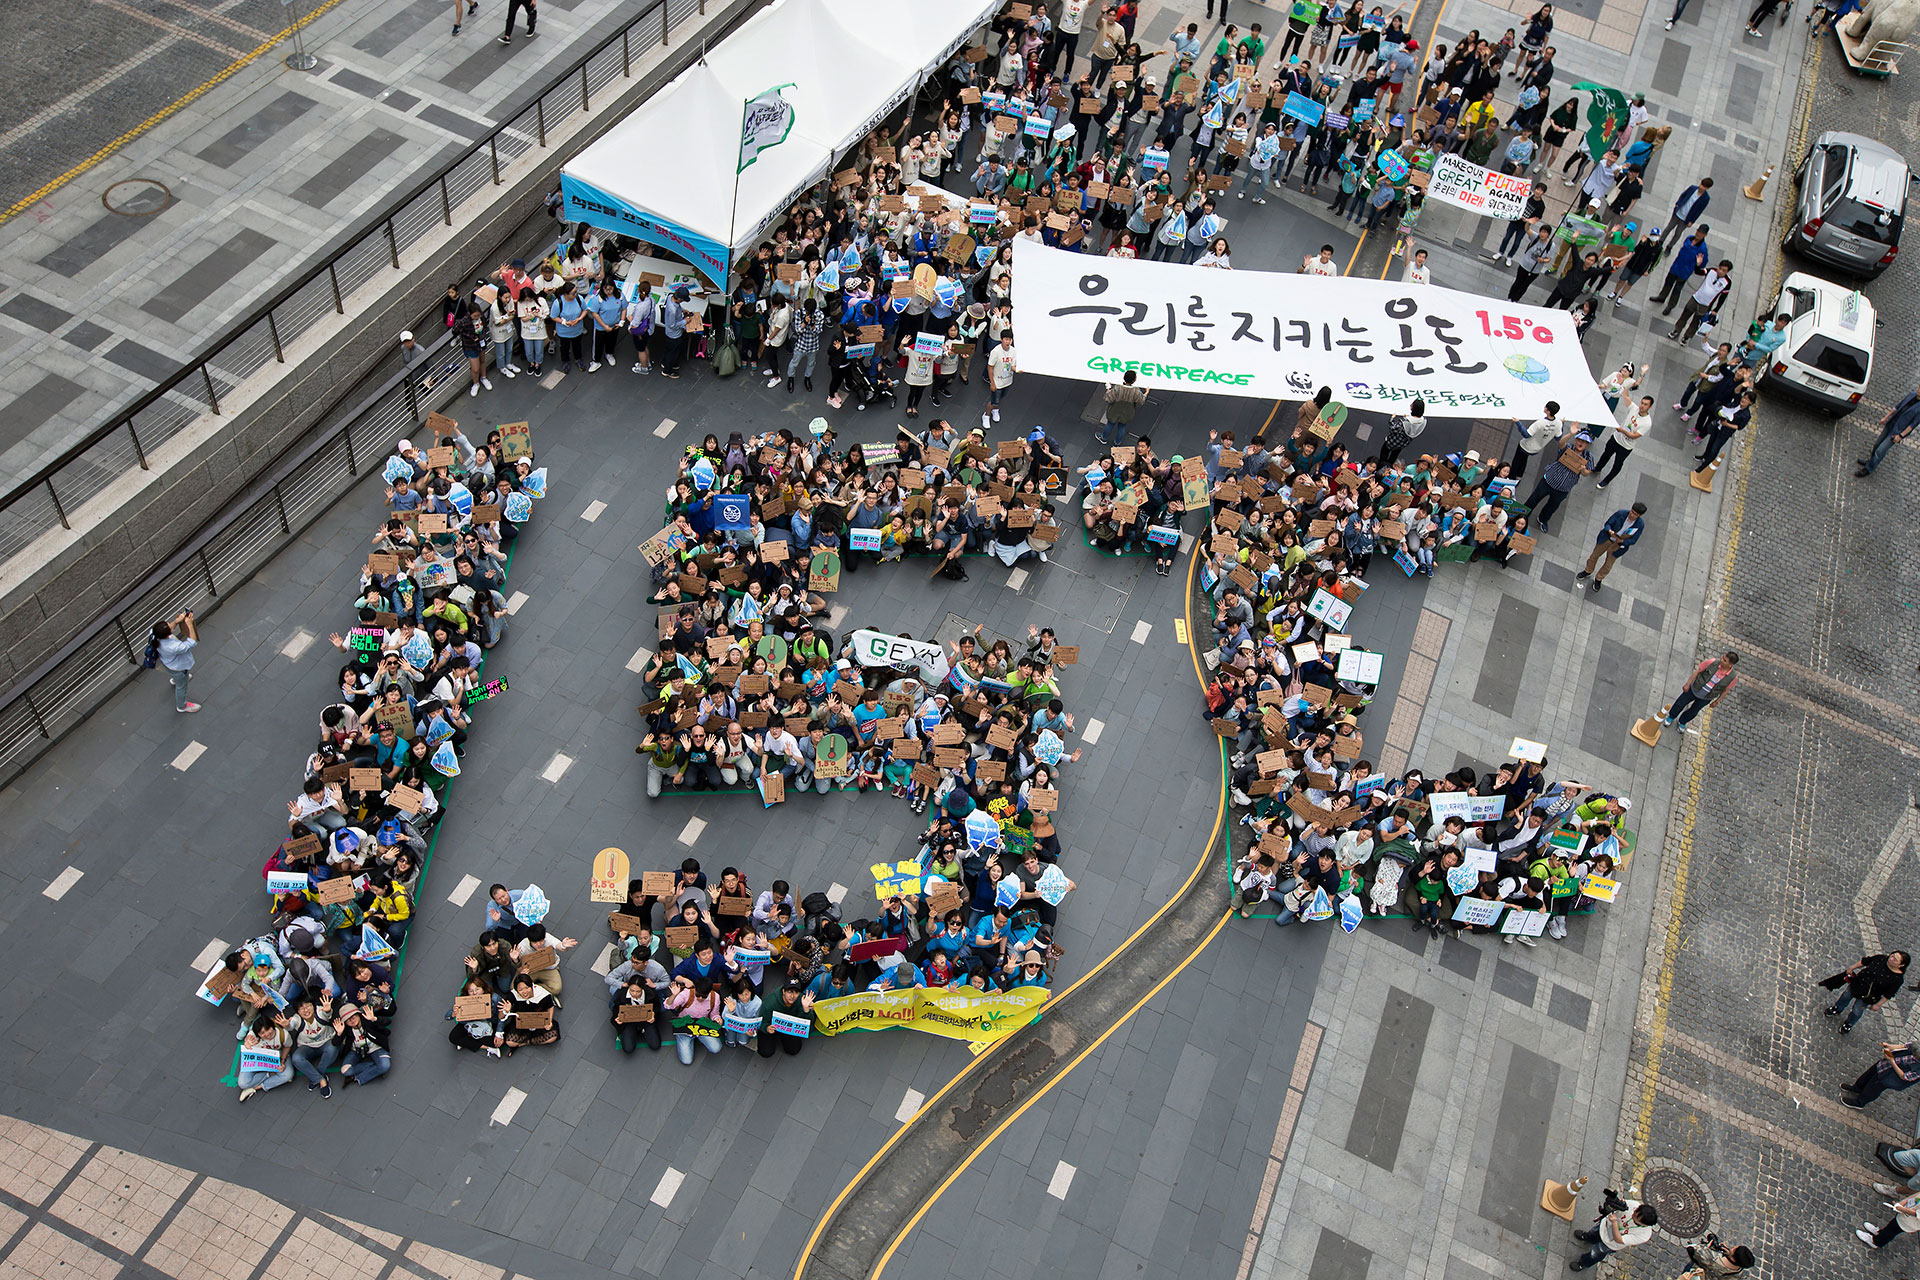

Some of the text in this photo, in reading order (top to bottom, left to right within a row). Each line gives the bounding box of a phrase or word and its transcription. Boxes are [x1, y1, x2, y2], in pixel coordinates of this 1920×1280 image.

[1443, 156, 1467, 172] MAKE
[1467, 165, 1484, 180] OUR
[1433, 182, 1457, 198] 우리의
[1437, 168, 1532, 197] GREAT FUTURE
[1488, 189, 1523, 204] AGAIN
[1049, 274, 1488, 376] 우리를 지키는 온도
[1086, 355, 1256, 387] GREENPEACE
[1373, 384, 1507, 408] 환경운동연합
[351, 626, 384, 637] WANTED
[870, 637, 943, 665] GEYK
[465, 678, 501, 698] Light OFF
[878, 1006, 916, 1022] No!!!
[687, 1024, 721, 1037] Yes
